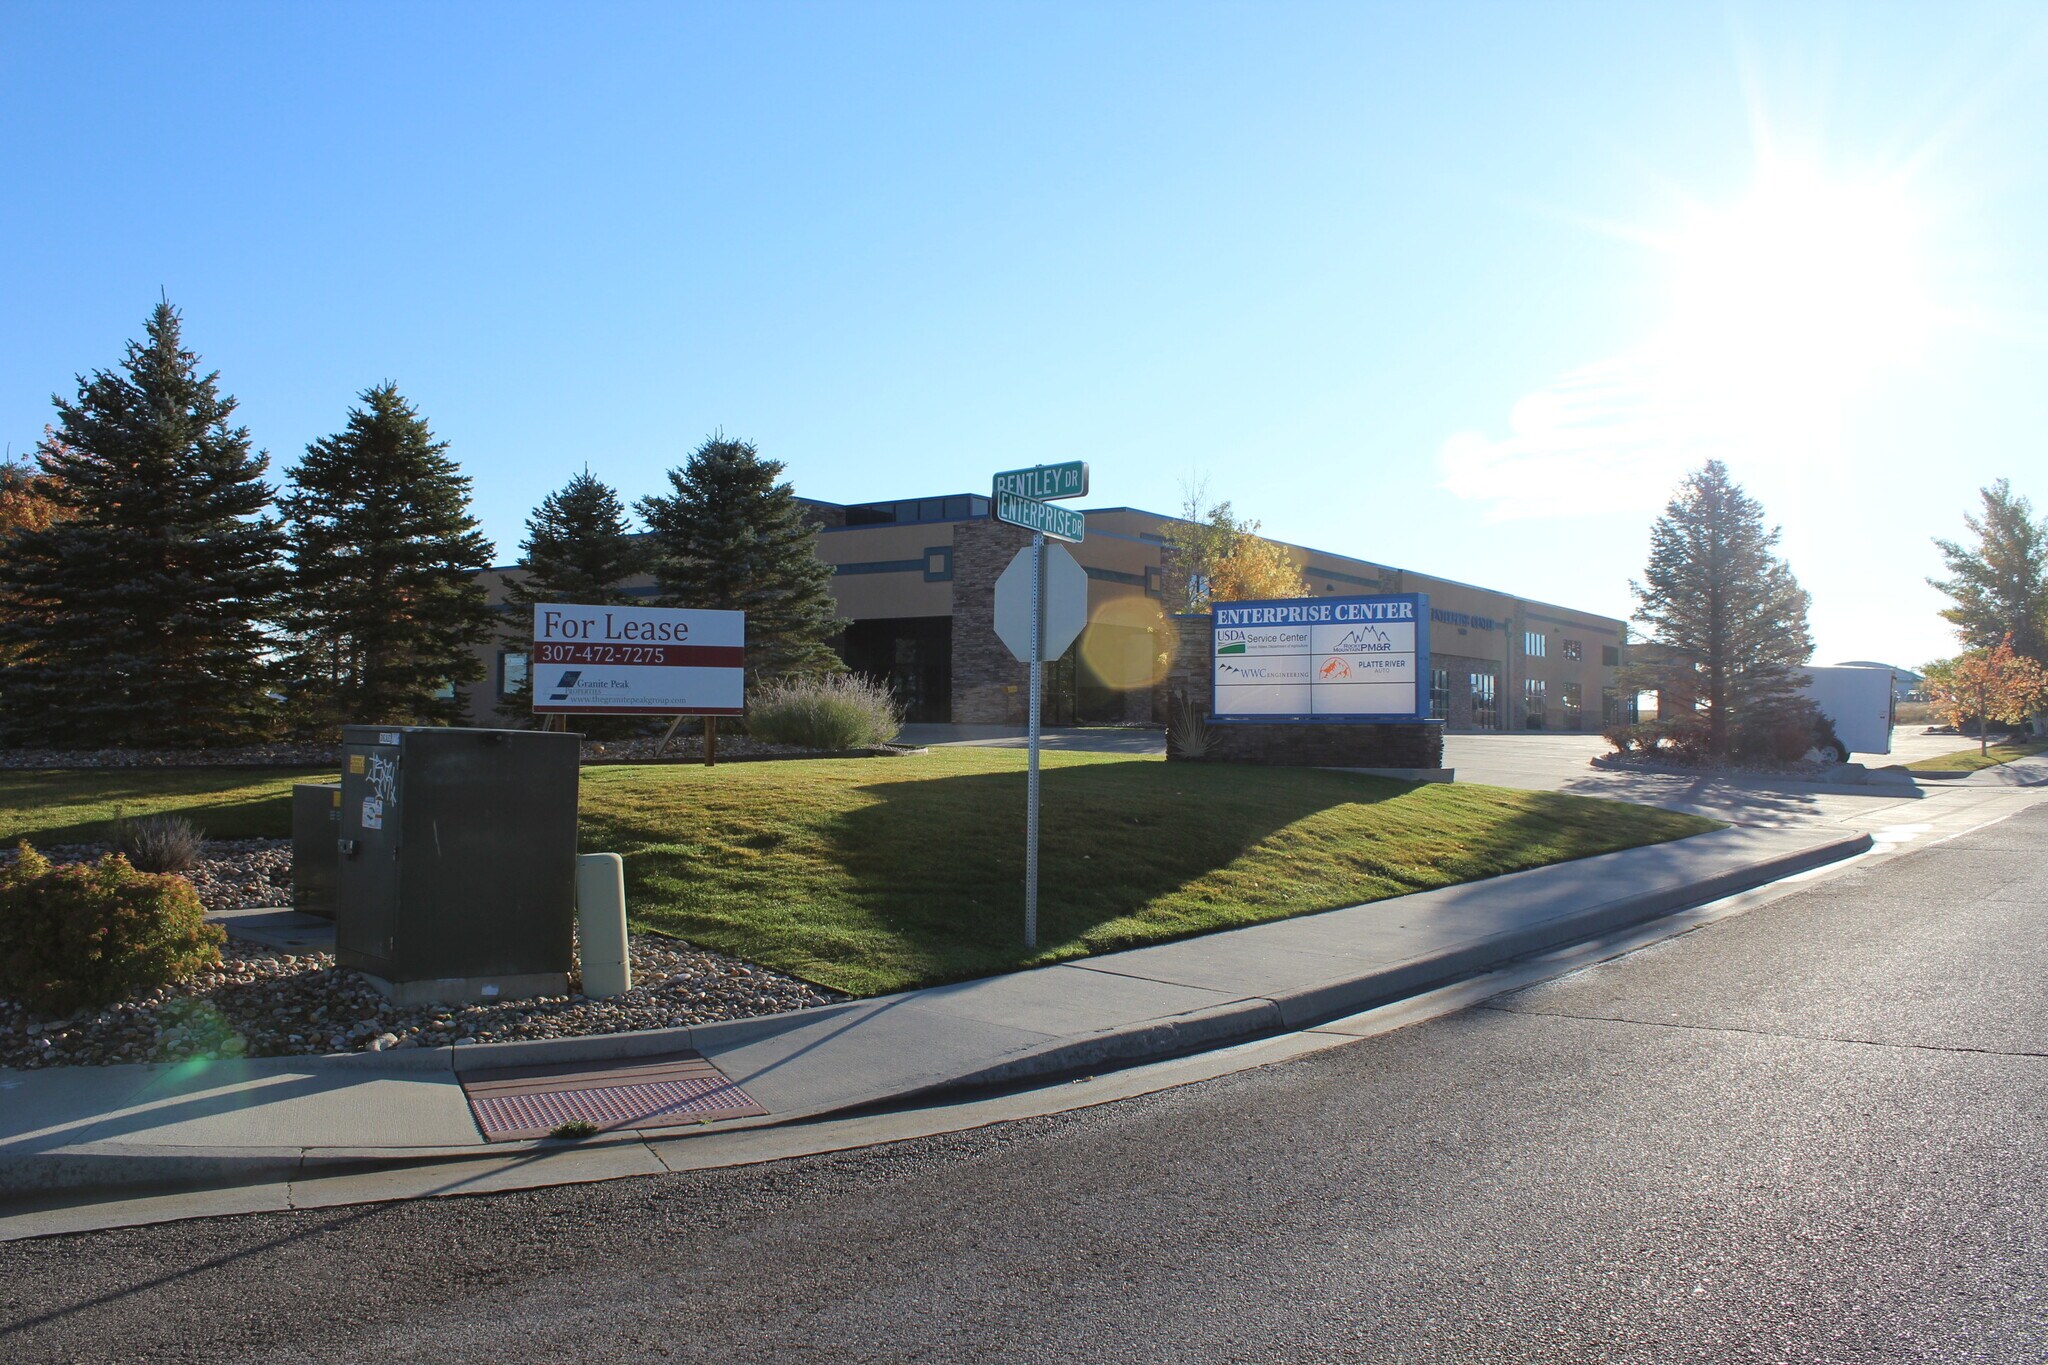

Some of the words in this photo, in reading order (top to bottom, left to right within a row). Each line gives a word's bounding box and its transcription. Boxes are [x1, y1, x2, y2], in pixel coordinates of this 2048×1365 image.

[997, 468, 1062, 497] BENTLEY
[1065, 470, 1078, 488] DR
[1001, 492, 1071, 537] ENTERPRISE
[1072, 518, 1083, 536] DR
[1217, 606, 1331, 625] ENTERPRISE
[1335, 602, 1413, 620] CENTER
[544, 611, 595, 639] For
[604, 613, 689, 641] Lease
[1217, 630, 1246, 641] USDA
[1247, 634, 1277, 643] Service
[1280, 633, 1308, 642] Center
[542, 645, 665, 663] 307-472-7275
[1360, 643, 1391, 652] PM&R
[1241, 669, 1267, 678] WWC
[577, 679, 609, 688] Granite
[611, 680, 630, 688] Peak
[570, 695, 687, 705] www.thegranitepeakgroup.com
